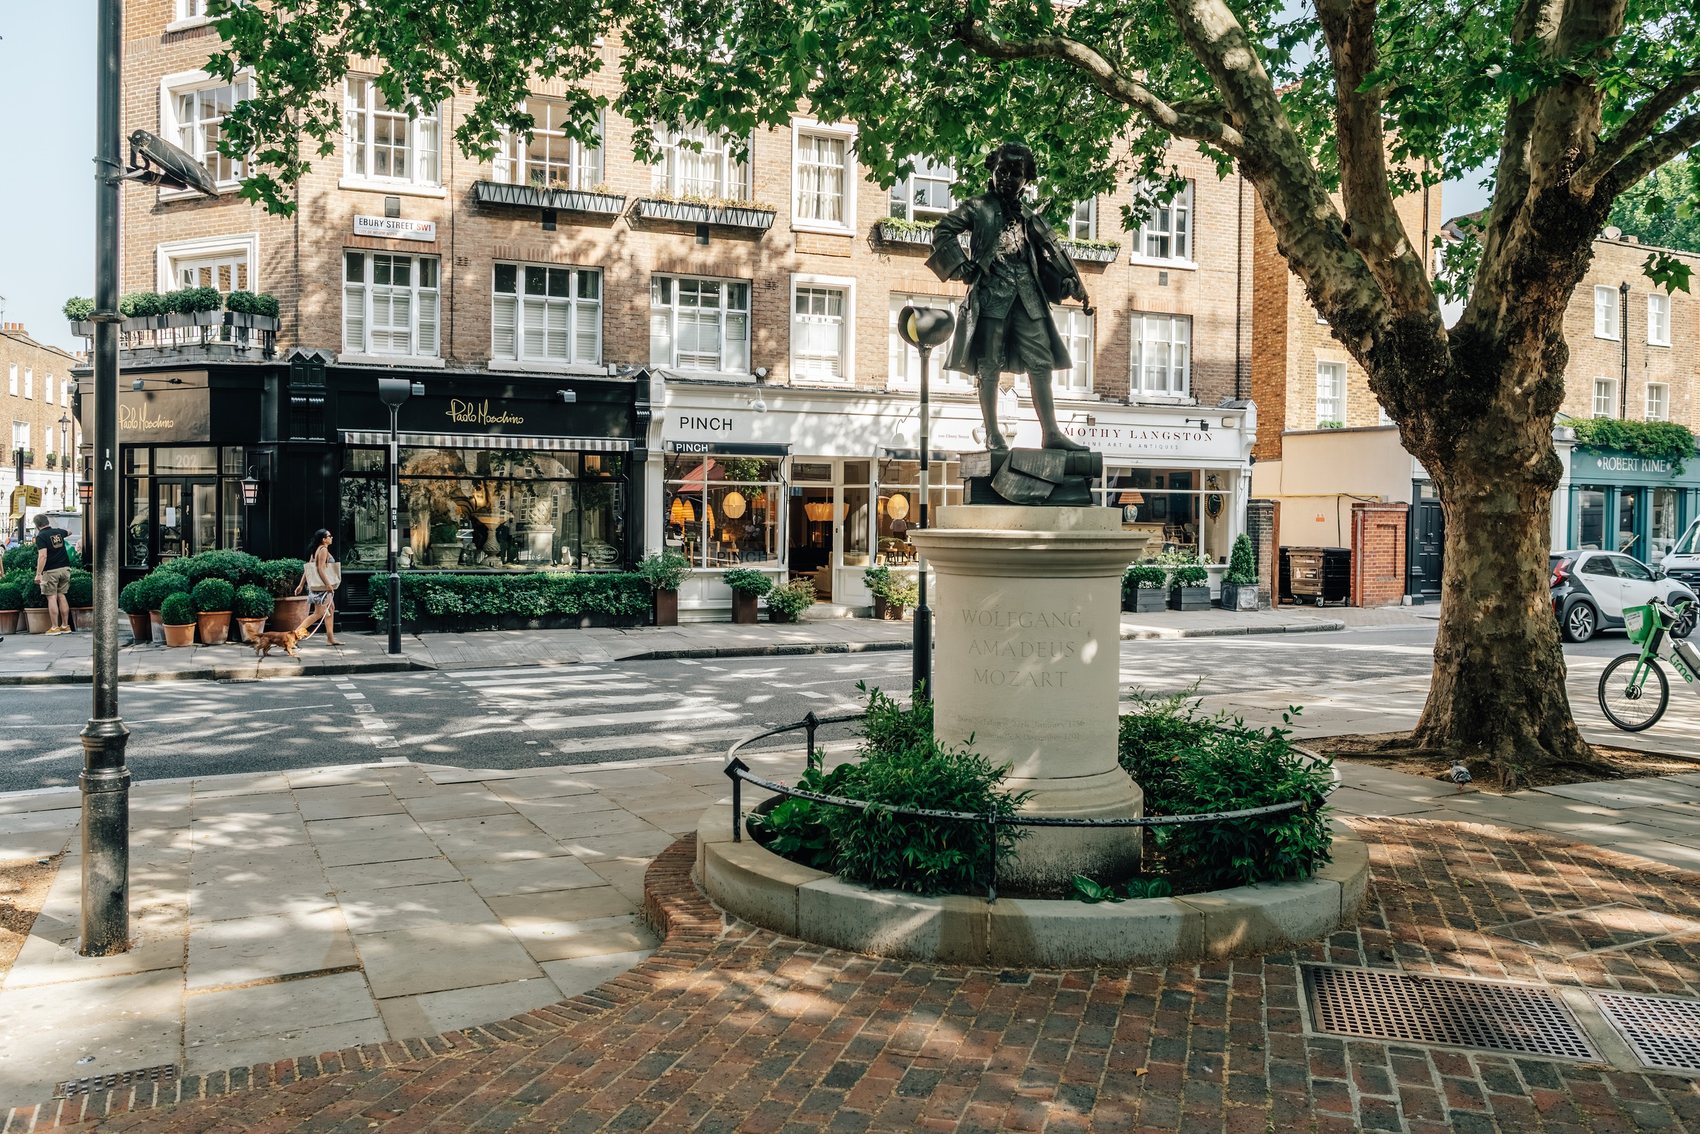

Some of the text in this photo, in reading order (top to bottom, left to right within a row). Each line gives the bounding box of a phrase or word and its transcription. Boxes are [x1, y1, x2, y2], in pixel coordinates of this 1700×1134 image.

[358, 217, 432, 232] EBURY STREET SW1
[445, 398, 525, 426] Paolo Moschino
[679, 416, 733, 431] PINCH
[1130, 430, 1214, 442] LANGSTON
[676, 443, 709, 452] PINCH
[175, 454, 198, 468] 202
[1602, 456, 1666, 473] ROBERT KIME
[717, 551, 768, 563] PINCH
[962, 608, 1081, 629] WOLFGANG
[968, 639, 1076, 658] AMADEUS
[1669, 653, 1694, 684] Lime
[973, 667, 1069, 688] MOZART
